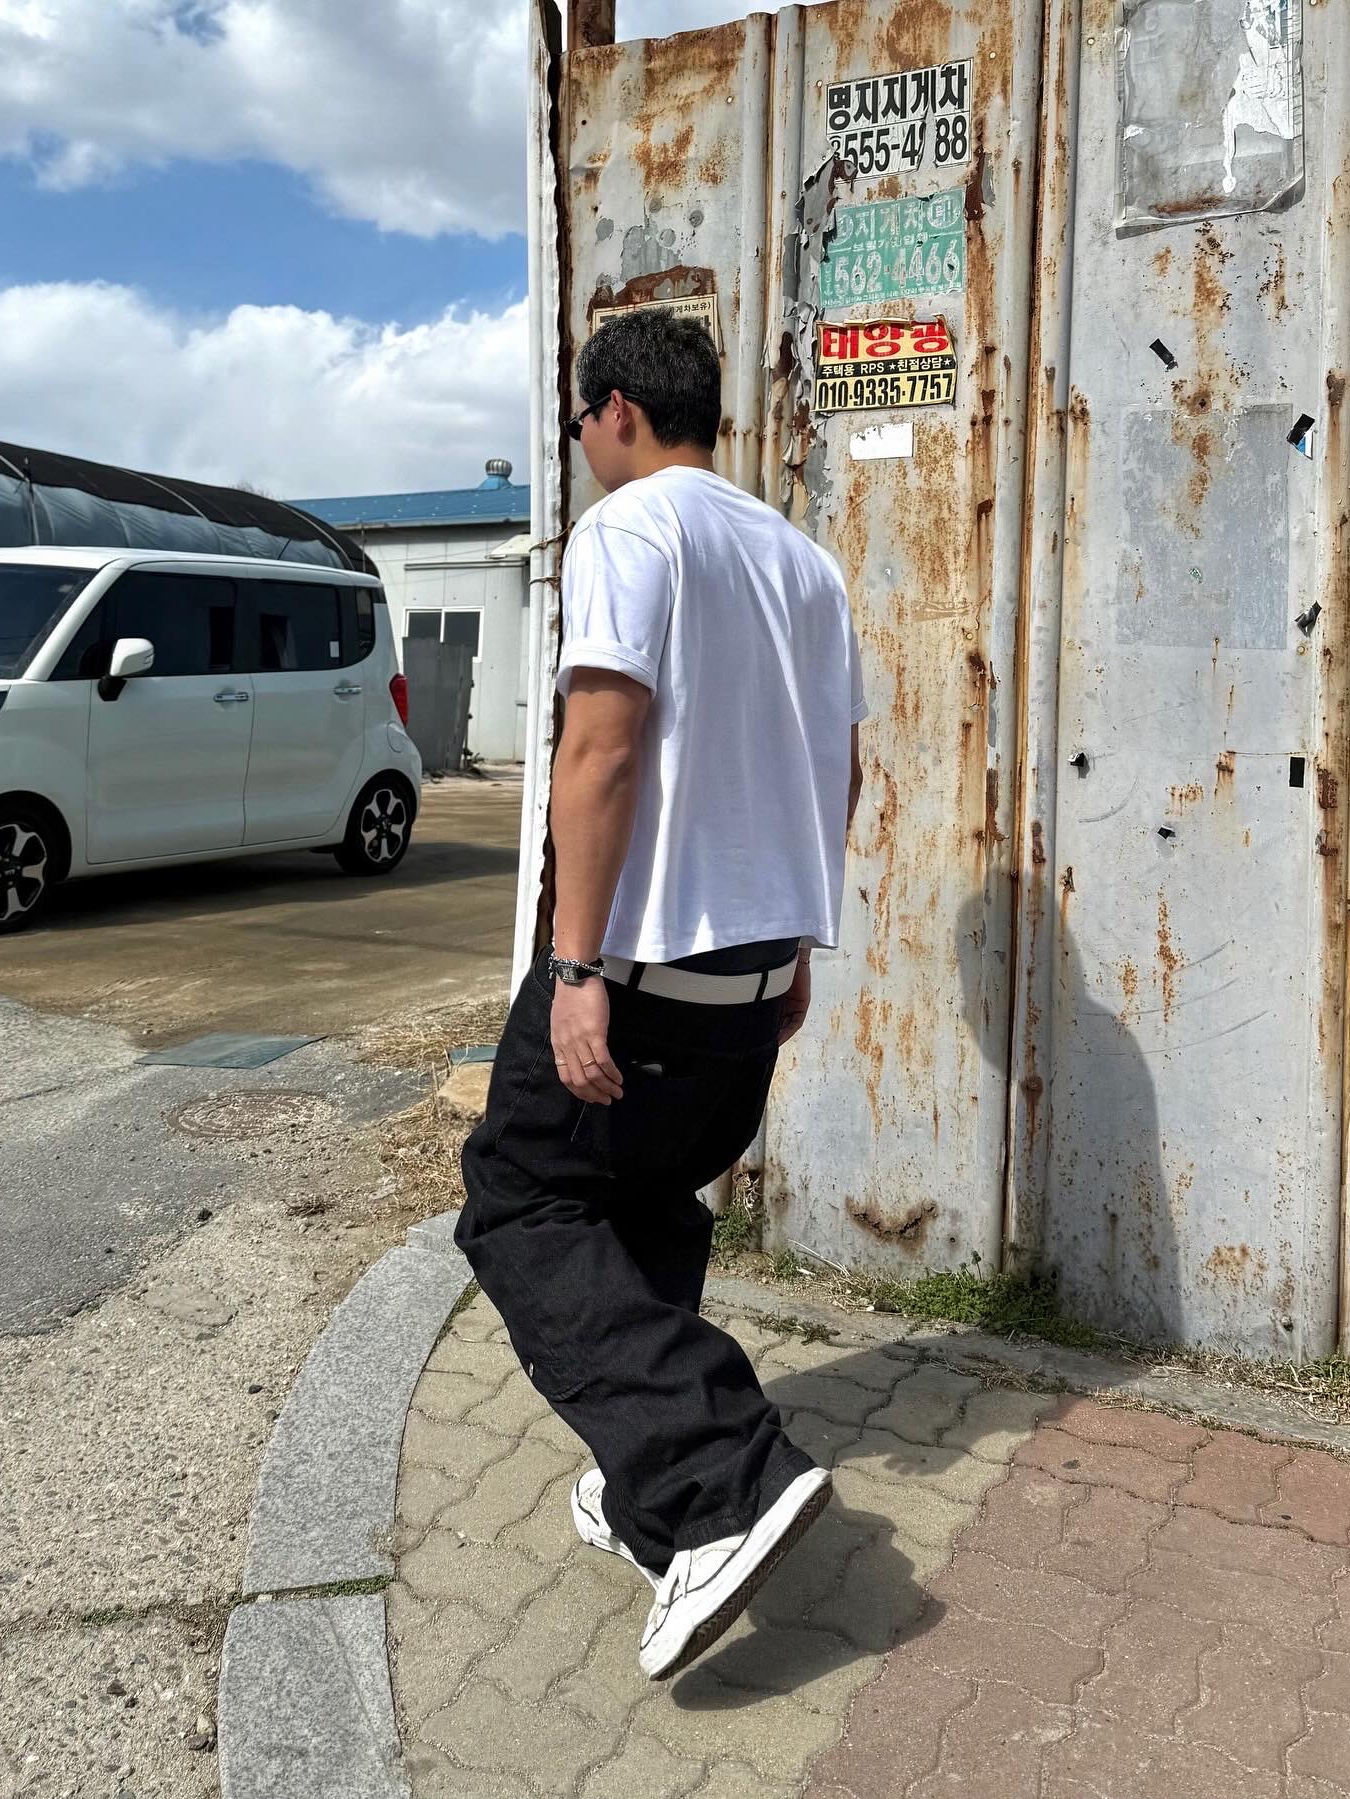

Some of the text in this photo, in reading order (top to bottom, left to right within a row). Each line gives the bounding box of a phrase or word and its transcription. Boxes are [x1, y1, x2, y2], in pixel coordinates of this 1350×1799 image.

[829, 64, 967, 131] 명지지게차
[822, 364, 855, 378] 주택용
[860, 362, 885, 375] RPS
